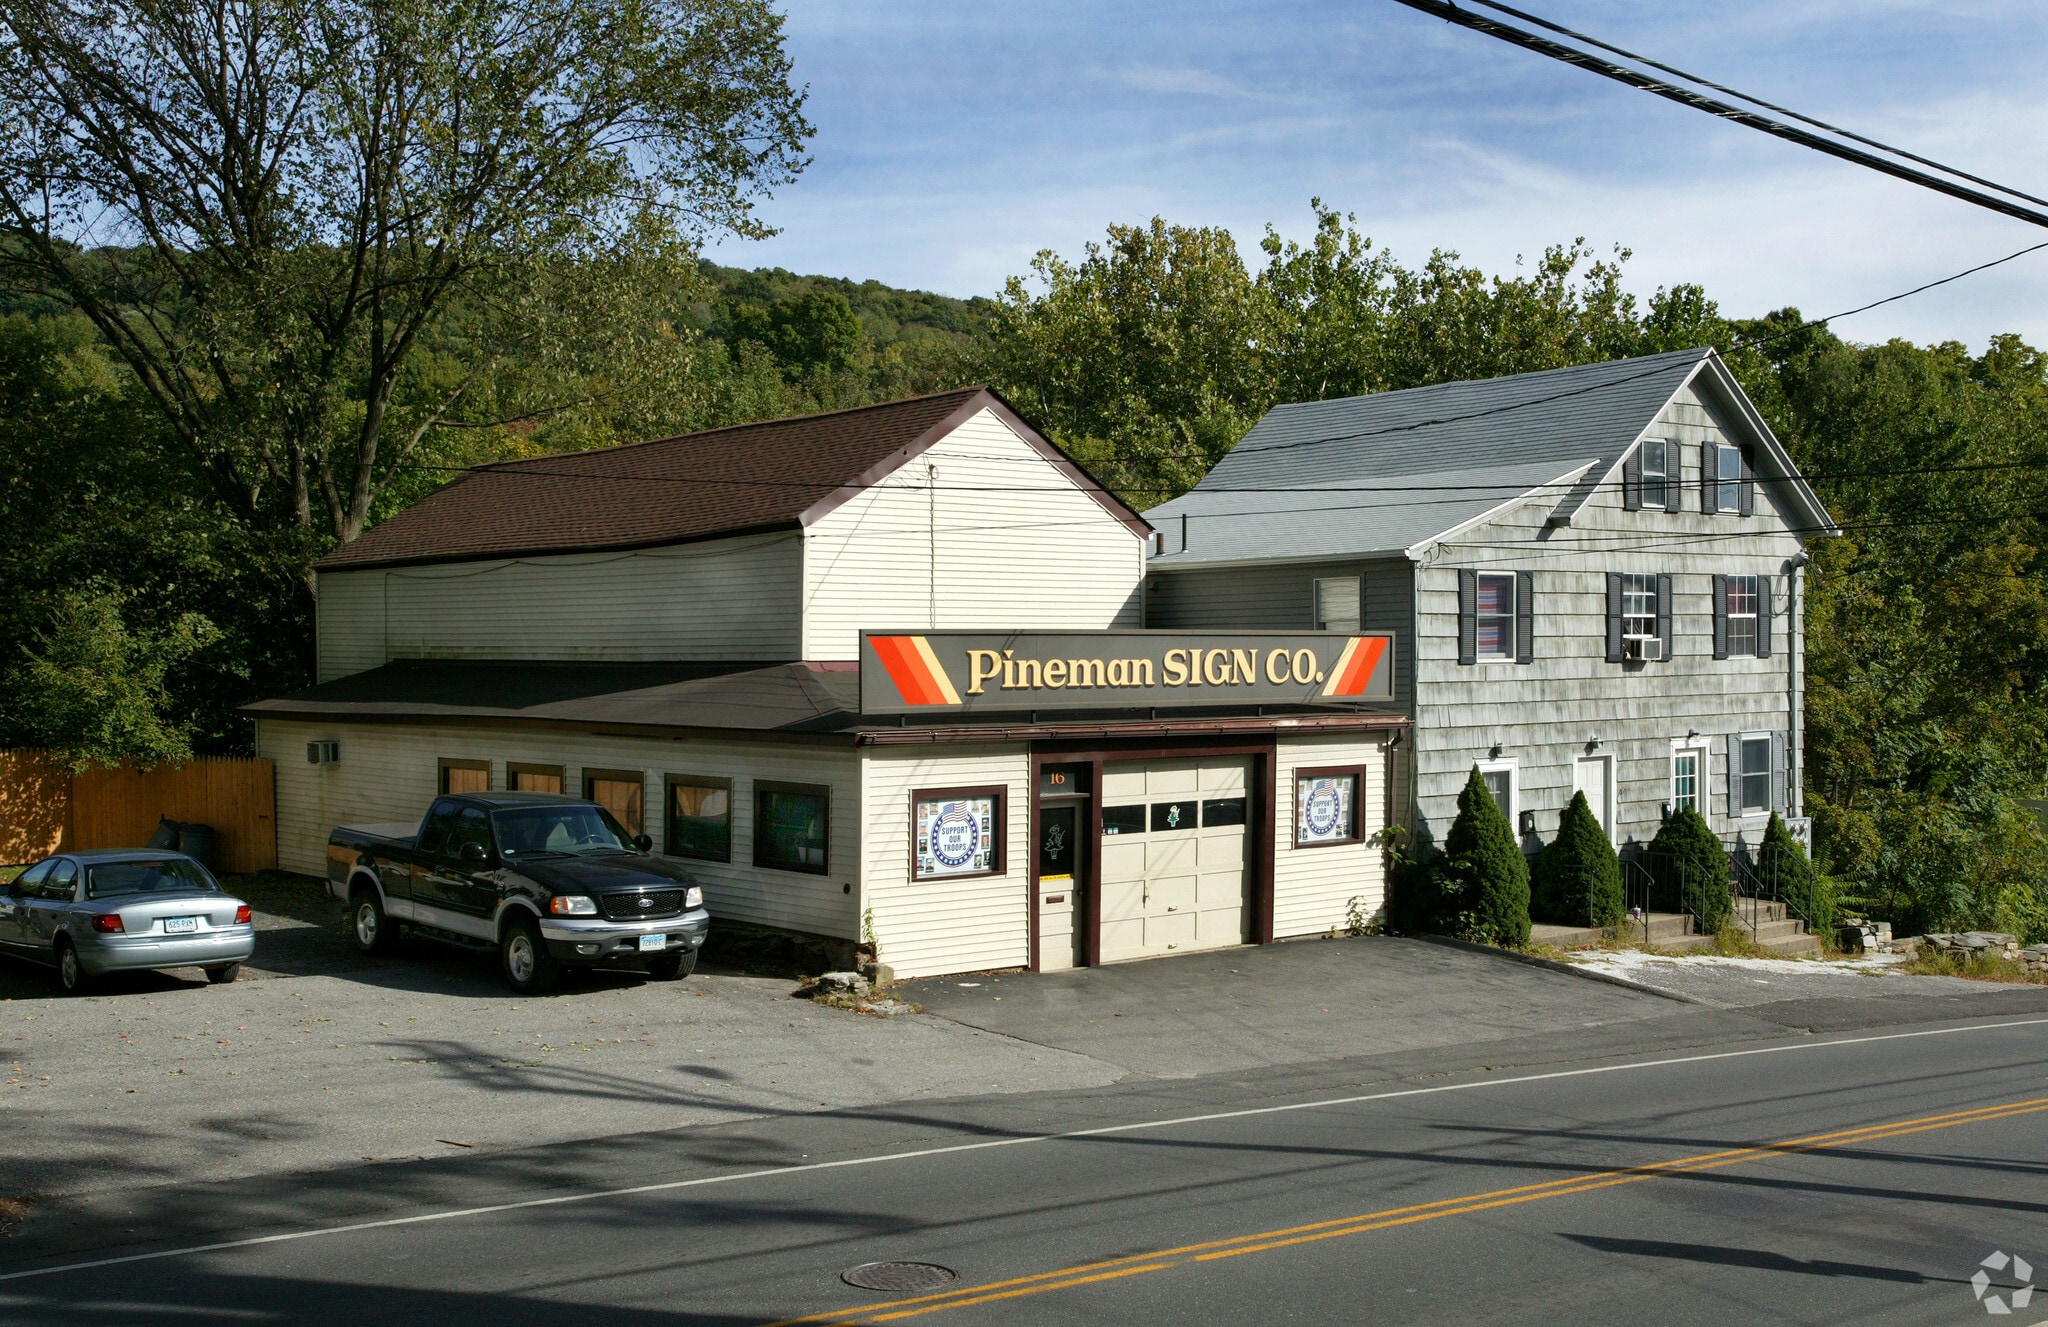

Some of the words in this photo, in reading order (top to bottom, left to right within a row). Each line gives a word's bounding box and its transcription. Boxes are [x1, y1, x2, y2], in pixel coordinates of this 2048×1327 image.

[966, 648, 1155, 694] Pineman
[1162, 648, 1258, 686] SIGN
[1265, 648, 1324, 685] CO.
[1050, 772, 1065, 785] 16
[941, 825, 968, 835] SUPPORT
[949, 835, 961, 843] OUR
[943, 843, 967, 852] TROOPS
